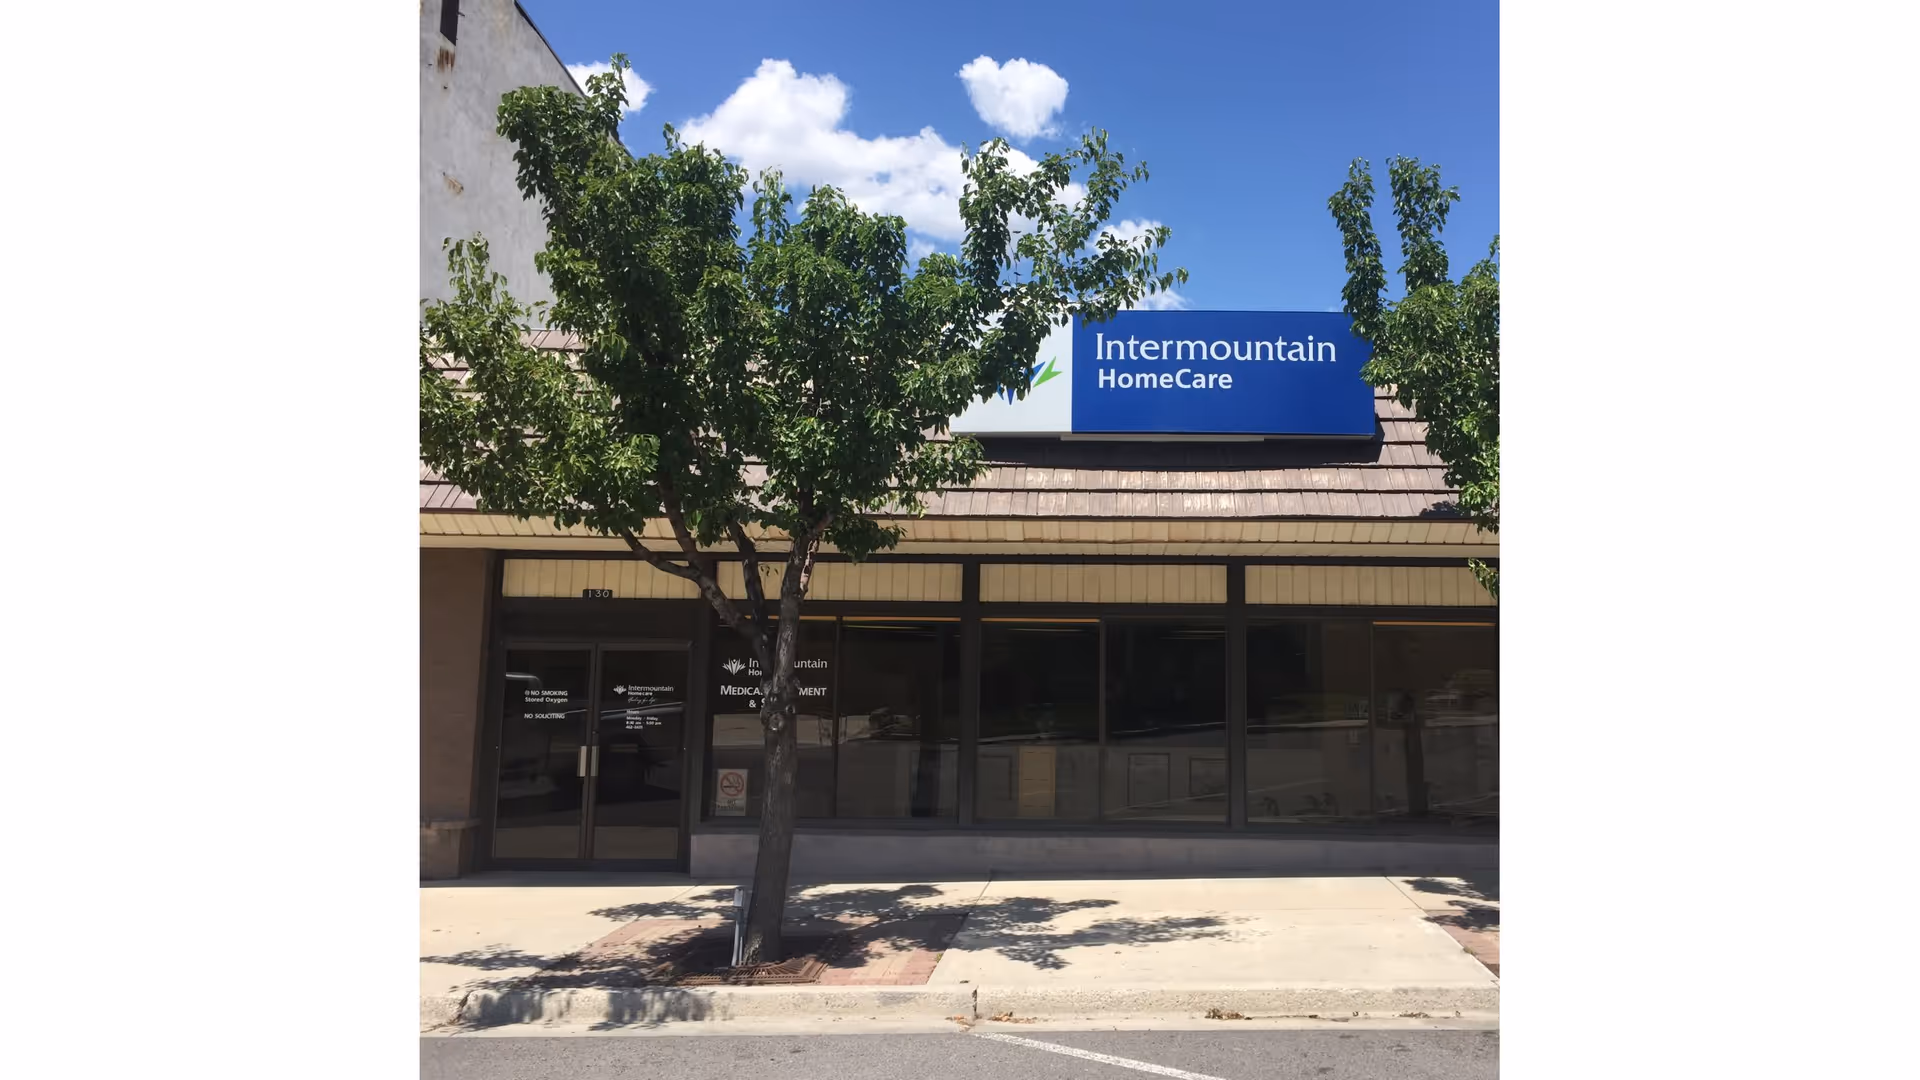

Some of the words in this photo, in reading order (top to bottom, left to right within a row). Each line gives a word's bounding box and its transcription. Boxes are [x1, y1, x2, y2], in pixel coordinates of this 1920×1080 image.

[1096, 332, 1337, 363] Intermountain
[1098, 368, 1233, 391] HomeCare
[588, 589, 610, 598] 130
[749, 657, 828, 669] Inuntain
[720, 685, 764, 696] MEDICA
